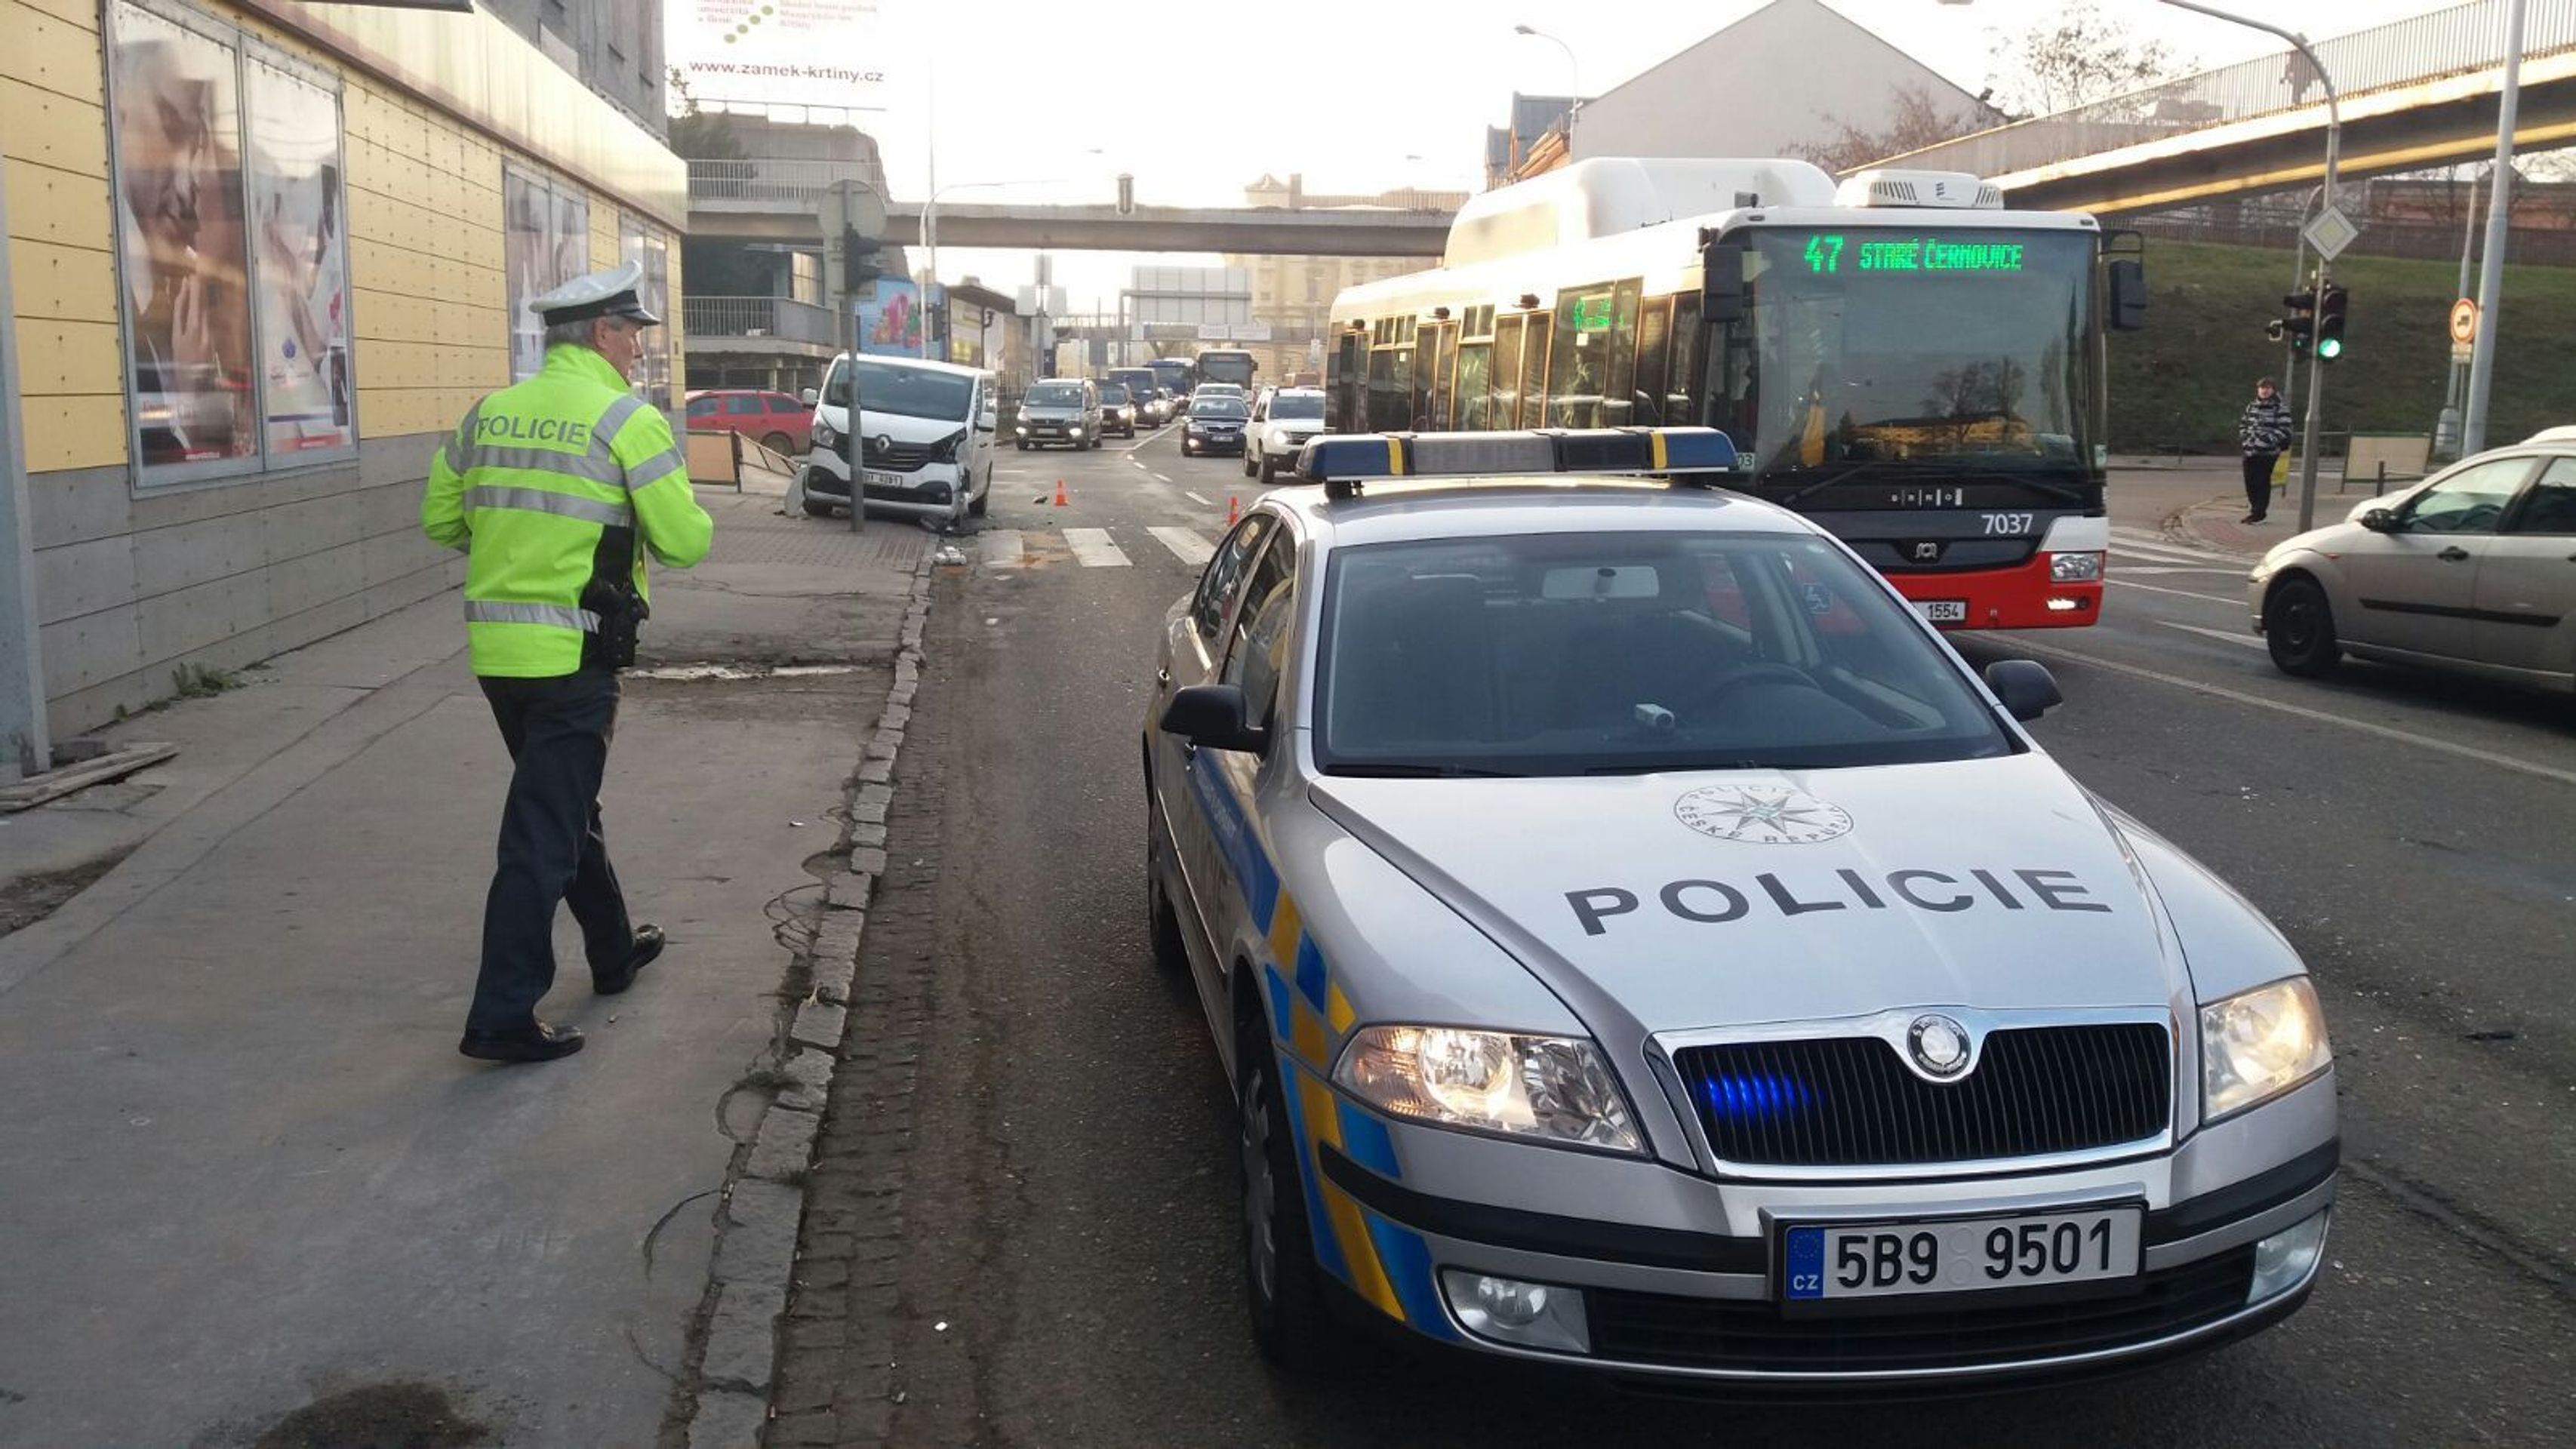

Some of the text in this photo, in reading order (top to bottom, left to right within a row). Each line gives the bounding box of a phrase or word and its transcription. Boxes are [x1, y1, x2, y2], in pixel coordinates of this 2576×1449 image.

[688, 60, 885, 82] www.zamek-krtiny.cz
[1804, 235, 2024, 272] 47 STARÉ ČERNOVICE
[476, 415, 587, 448] POLICIE
[1981, 513, 2033, 534] 7037
[1928, 604, 1959, 618] 1554
[1564, 869, 2113, 936] POLICIE
[1837, 1218, 2112, 1289] 5B9 9501
[1793, 1273, 1819, 1291] CZ
